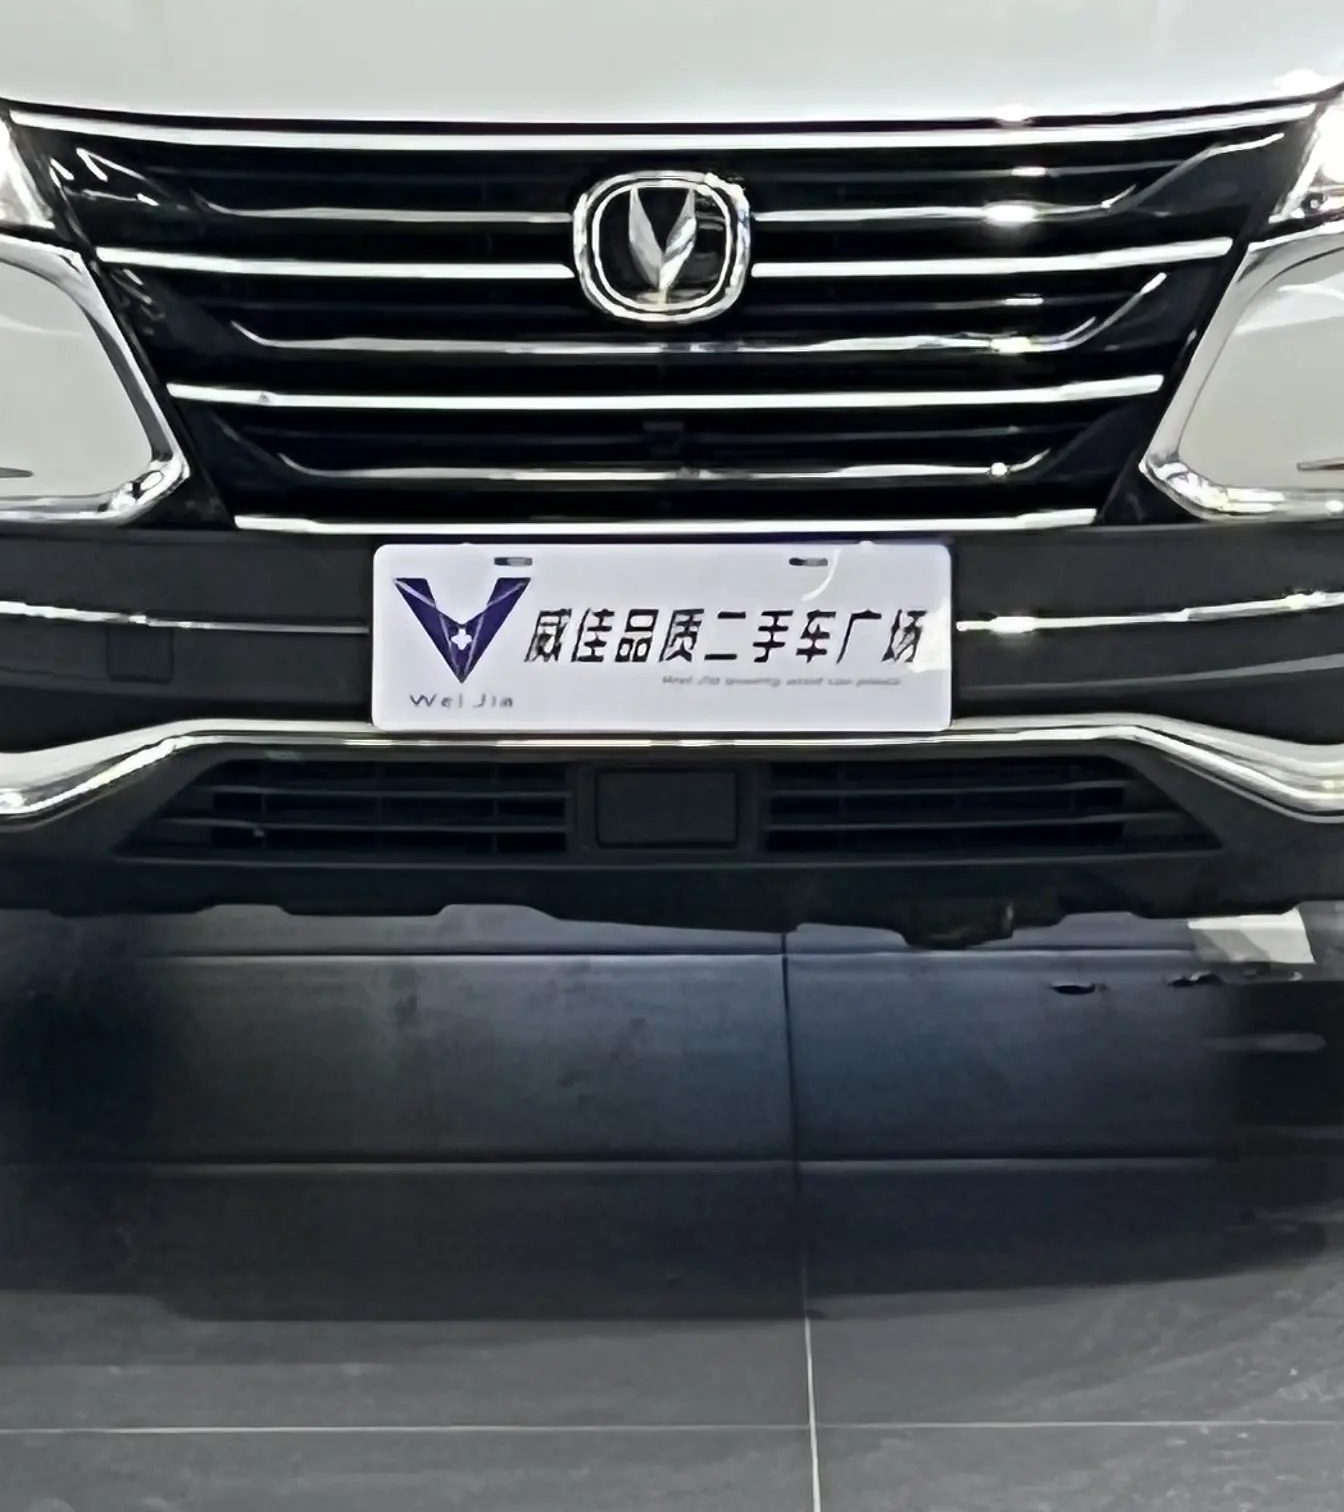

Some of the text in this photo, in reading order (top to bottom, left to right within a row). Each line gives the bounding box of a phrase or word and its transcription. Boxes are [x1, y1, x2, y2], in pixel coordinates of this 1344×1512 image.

[523, 607, 928, 664] 威佳品质二手车广场
